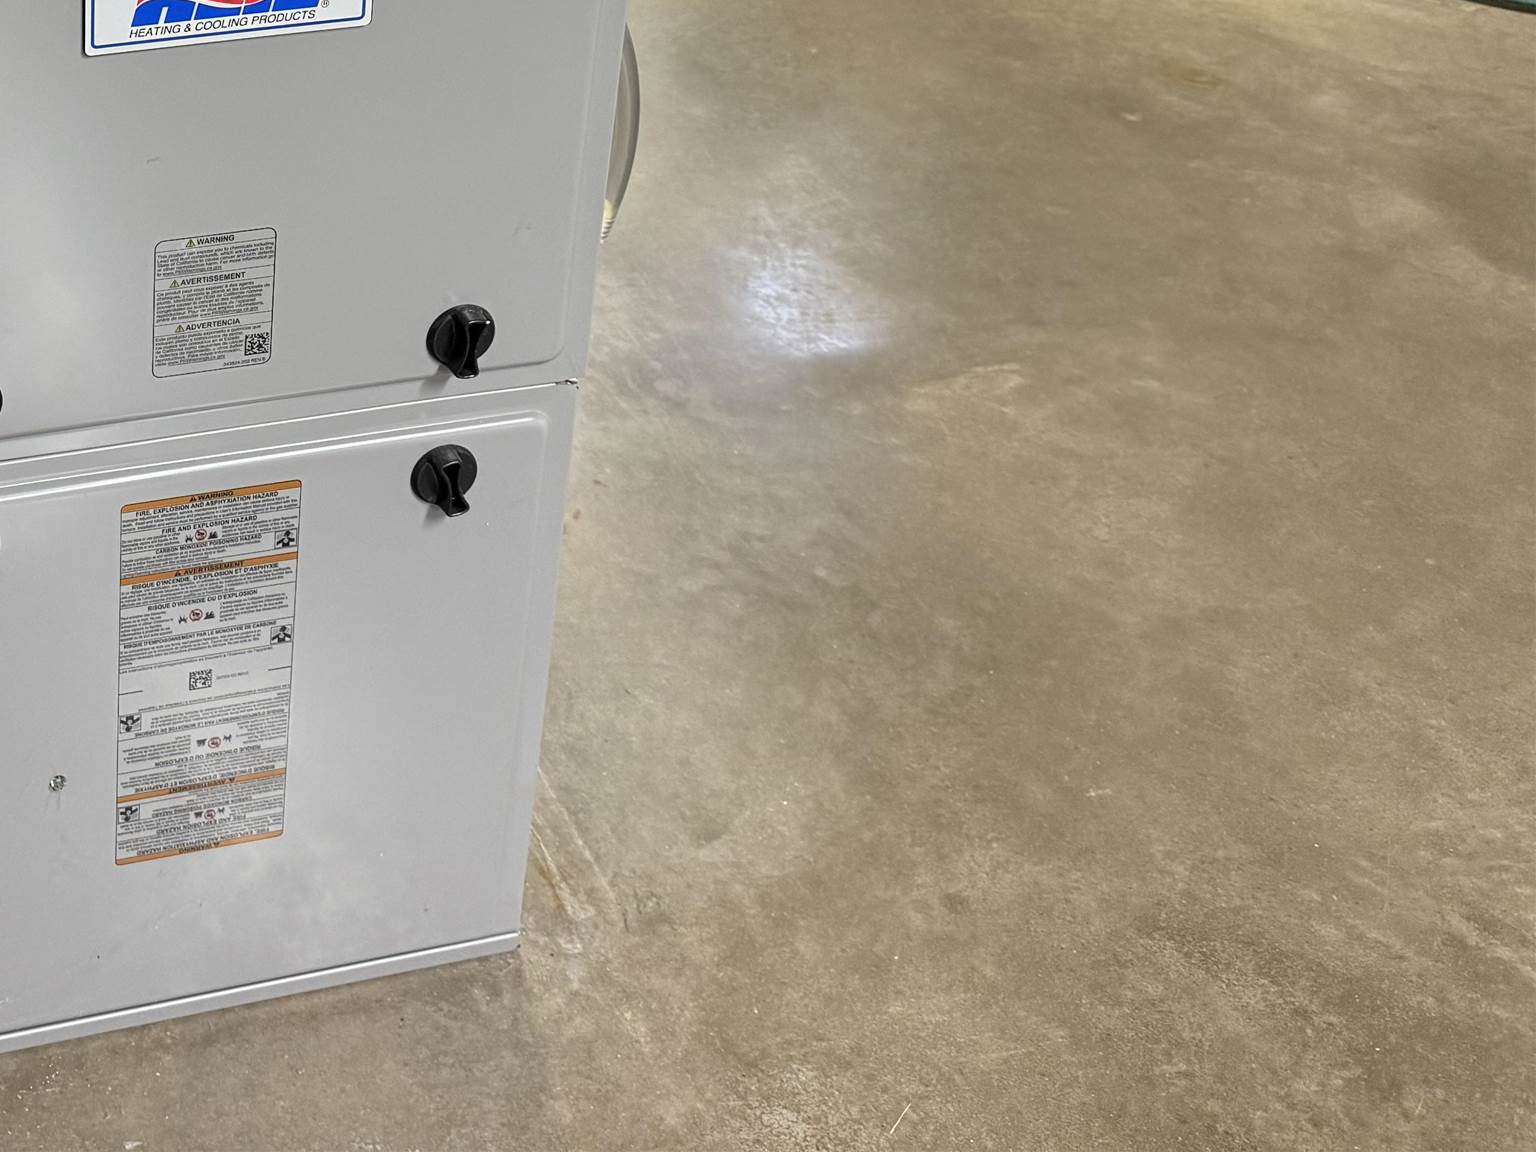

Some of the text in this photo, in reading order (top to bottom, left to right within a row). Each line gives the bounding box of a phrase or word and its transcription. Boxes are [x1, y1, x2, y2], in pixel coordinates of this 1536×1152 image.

[129, 9, 316, 39] HEATING & COOLING PRODUCTS
[196, 234, 235, 245] WARNING
[180, 271, 246, 286] AVERTISSEMENT
[185, 318, 241, 332] ADVERTENCIA
